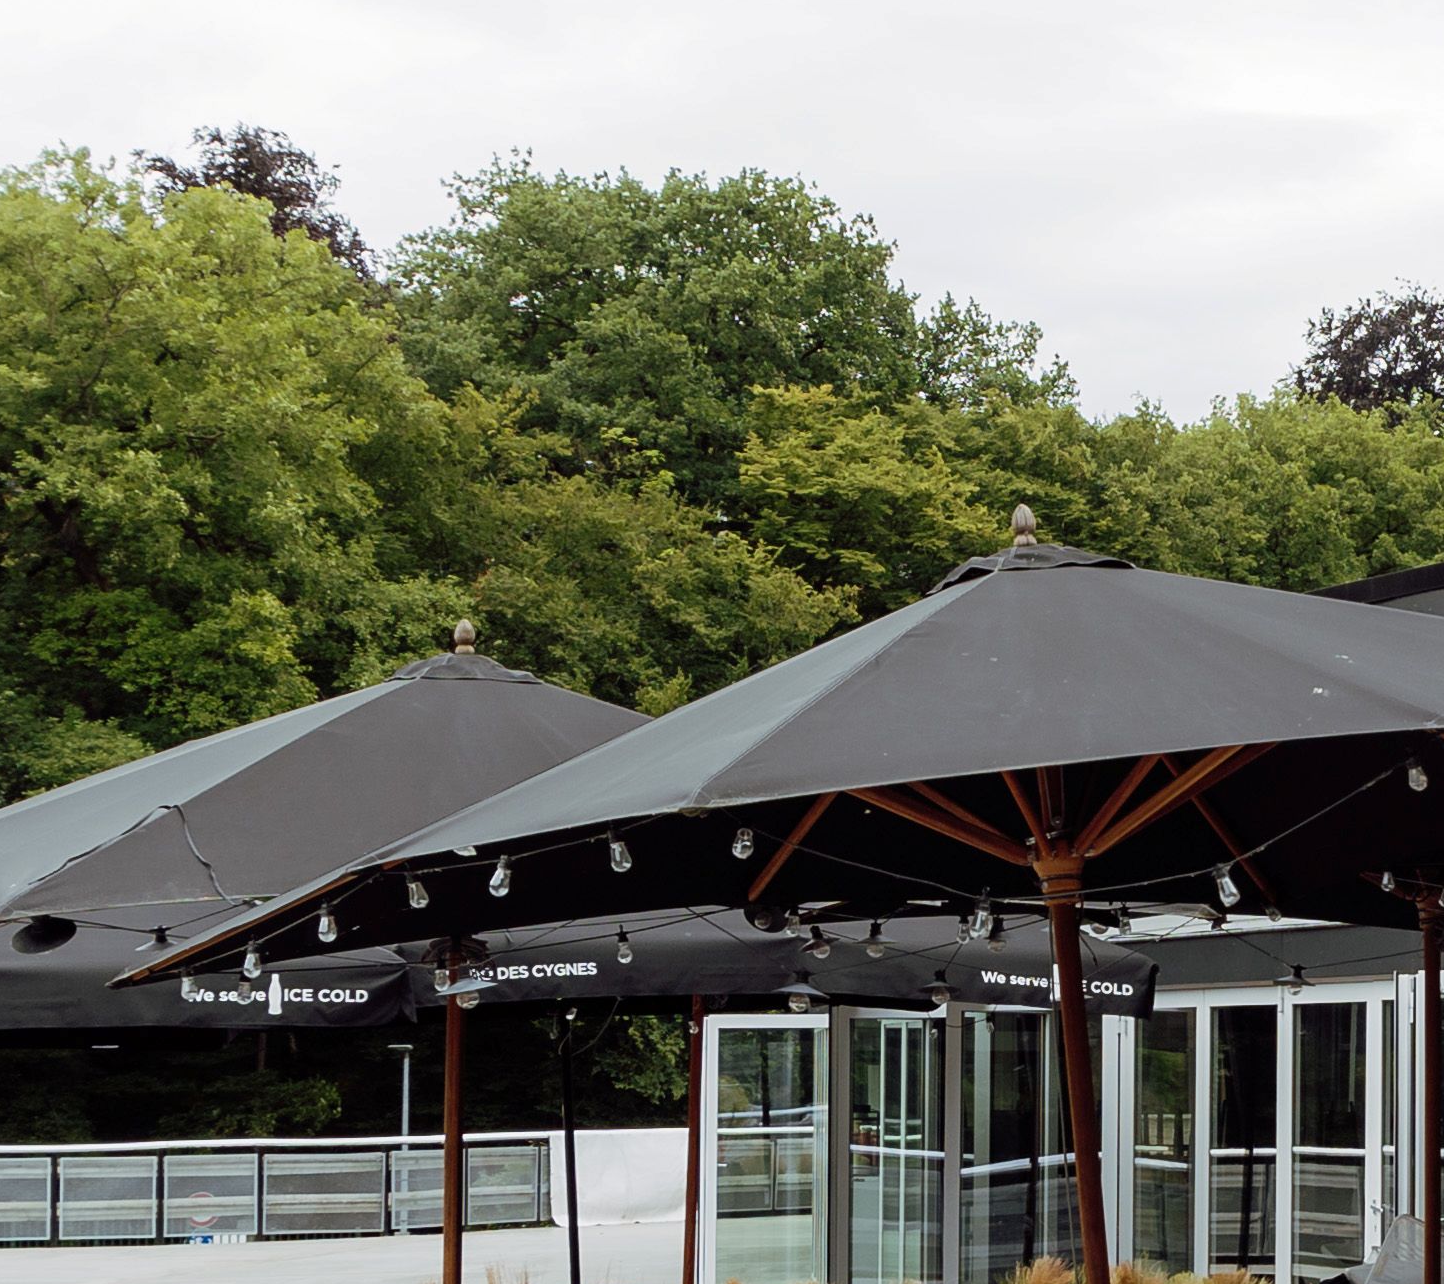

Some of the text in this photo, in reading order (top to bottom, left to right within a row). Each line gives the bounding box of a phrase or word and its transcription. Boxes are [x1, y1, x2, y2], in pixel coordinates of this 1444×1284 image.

[497, 967, 530, 981] DES
[531, 962, 598, 978] CYGNES
[981, 970, 1007, 984] We
[1009, 975, 1048, 988] serve
[1090, 981, 1134, 996] COLD
[218, 990, 266, 1002] see
[283, 988, 314, 1002] ICE
[318, 989, 369, 1003] COLD
